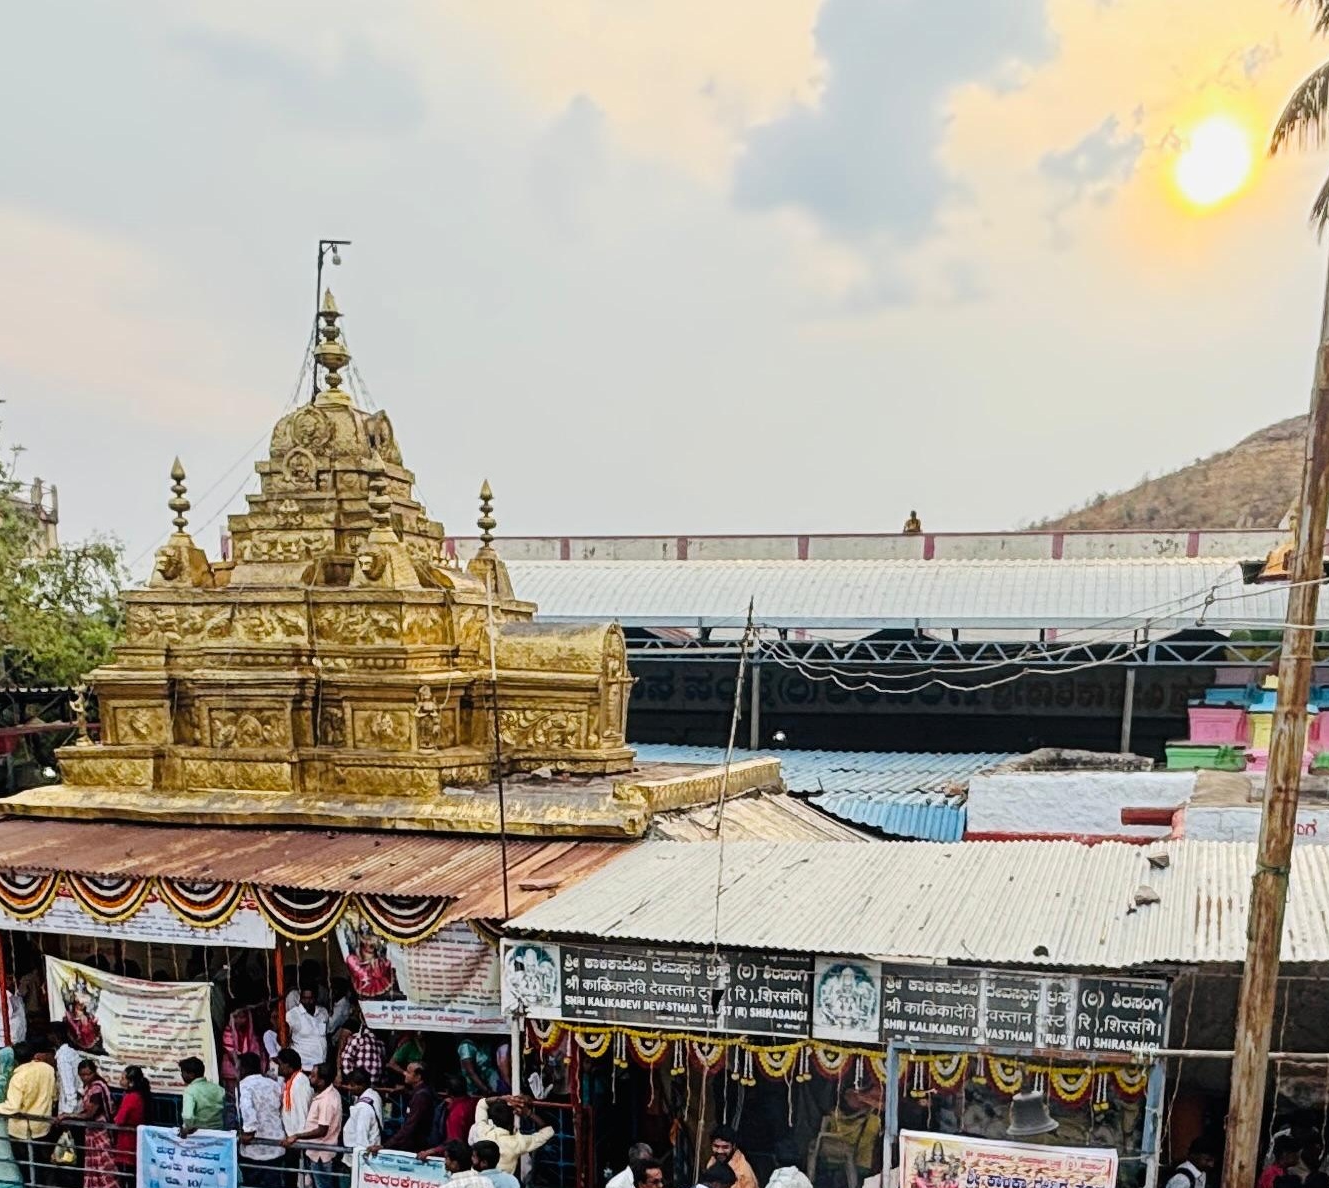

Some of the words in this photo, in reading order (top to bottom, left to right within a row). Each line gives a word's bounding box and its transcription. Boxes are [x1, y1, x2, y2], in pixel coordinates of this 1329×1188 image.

[565, 974, 580, 991] श्री
[564, 996, 586, 1007] SHRI
[588, 996, 641, 1011] KALIKADEVI
[884, 998, 901, 1017] श्री
[883, 1018, 908, 1031] SHRI
[909, 1021, 971, 1038] KALIKADEVI
